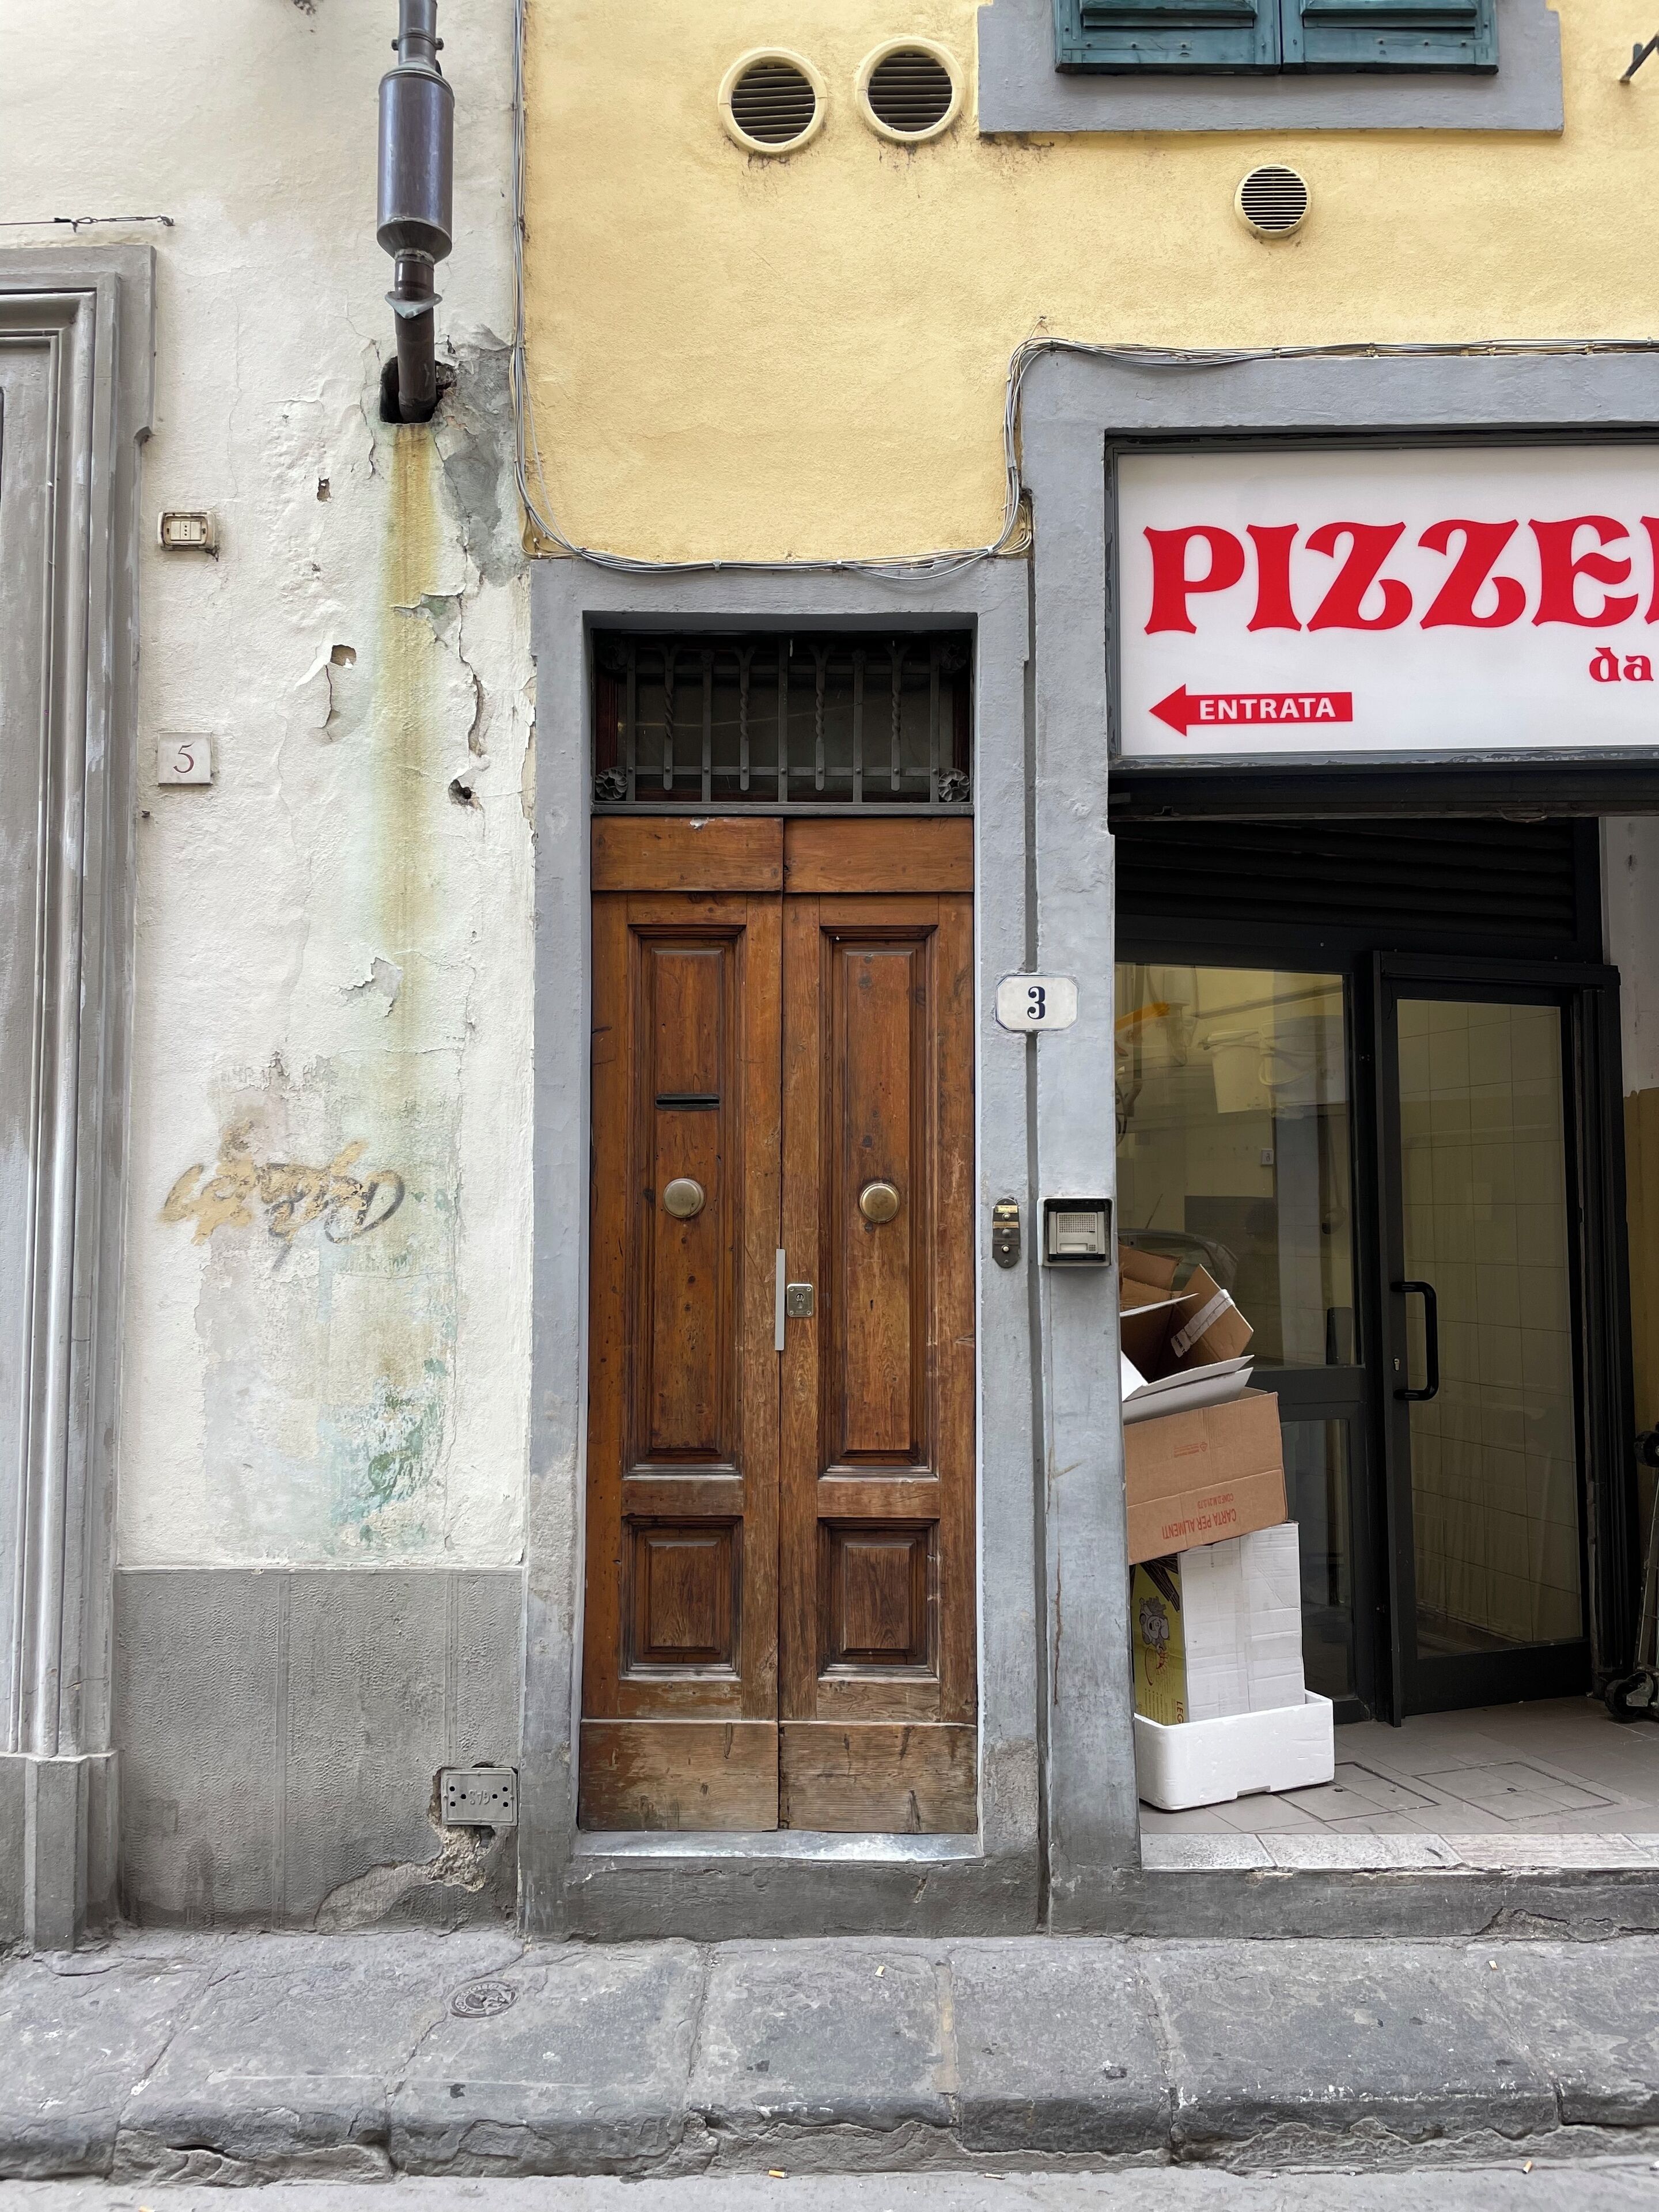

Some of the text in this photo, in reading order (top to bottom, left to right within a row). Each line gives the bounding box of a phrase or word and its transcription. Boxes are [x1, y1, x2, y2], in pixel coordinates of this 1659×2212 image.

[1143, 515, 1659, 635] PIZZE
[1589, 647, 1654, 682] da
[1199, 696, 1336, 721] ENTRATA
[173, 742, 195, 773] 5
[1027, 986, 1046, 1020] 3
[1161, 1508, 1237, 1540] CARTA PER ALIMENTI
[469, 1789, 490, 1805] GAS
